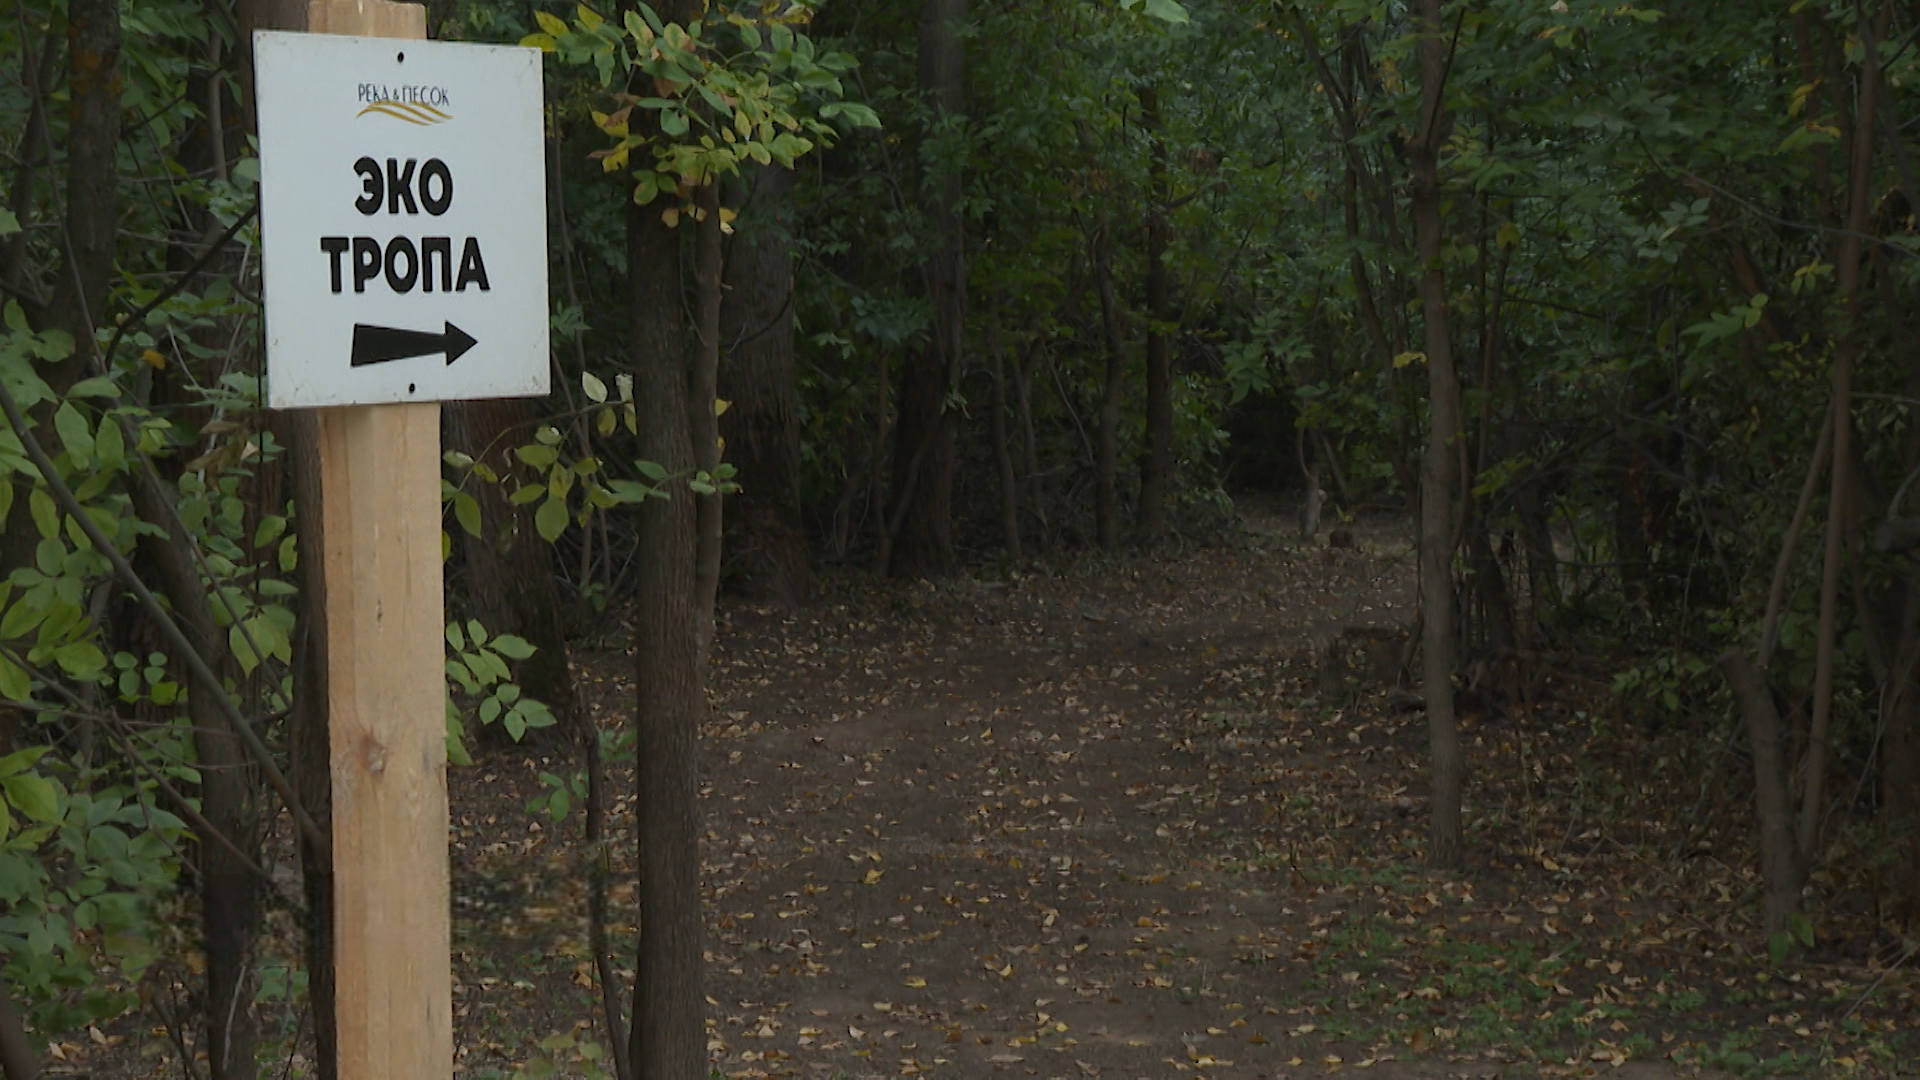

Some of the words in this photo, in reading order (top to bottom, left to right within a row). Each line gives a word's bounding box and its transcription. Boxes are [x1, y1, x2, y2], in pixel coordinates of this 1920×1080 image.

[358, 83, 389, 103] РЕКА
[402, 85, 450, 106] ПЕСОК
[353, 156, 454, 217] ЭКО
[320, 235, 491, 295] ТРОПА
